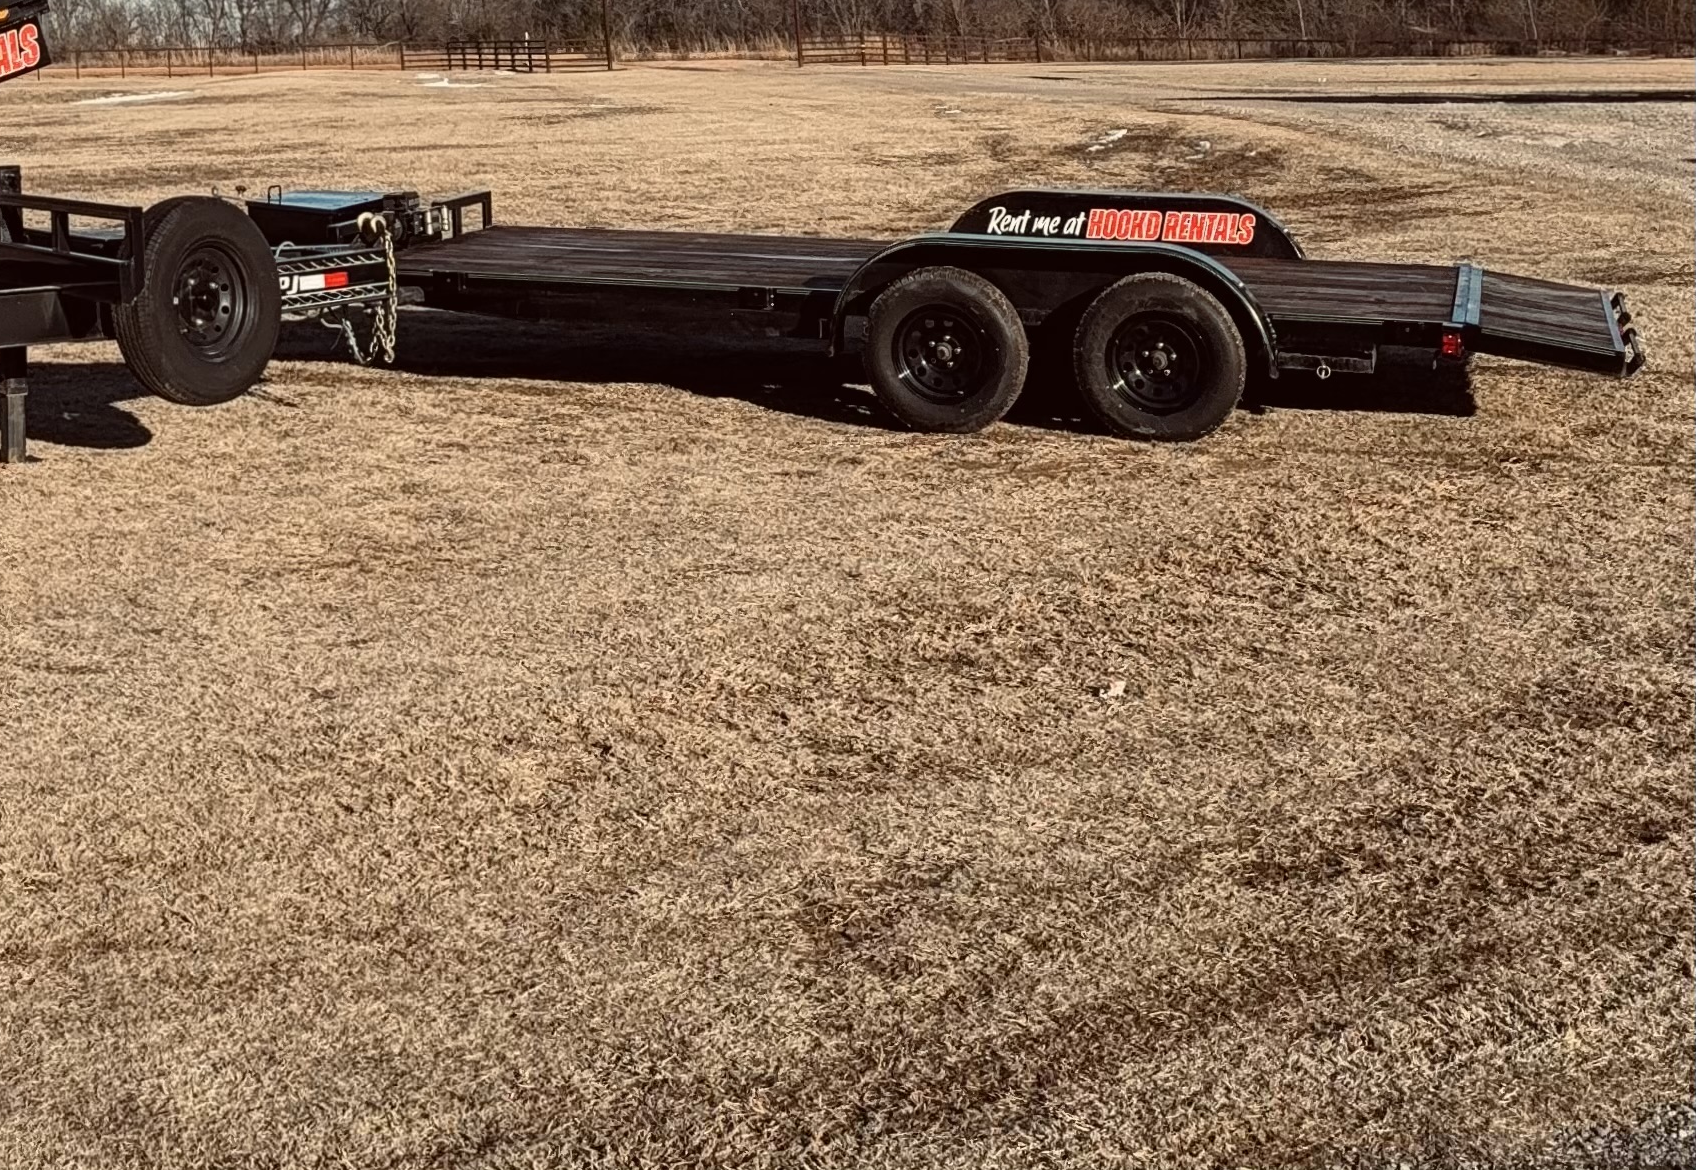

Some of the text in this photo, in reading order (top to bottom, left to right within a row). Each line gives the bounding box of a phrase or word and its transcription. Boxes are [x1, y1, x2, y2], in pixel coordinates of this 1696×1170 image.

[987, 206, 1256, 245] Rent me at HOOKD RENTALS
